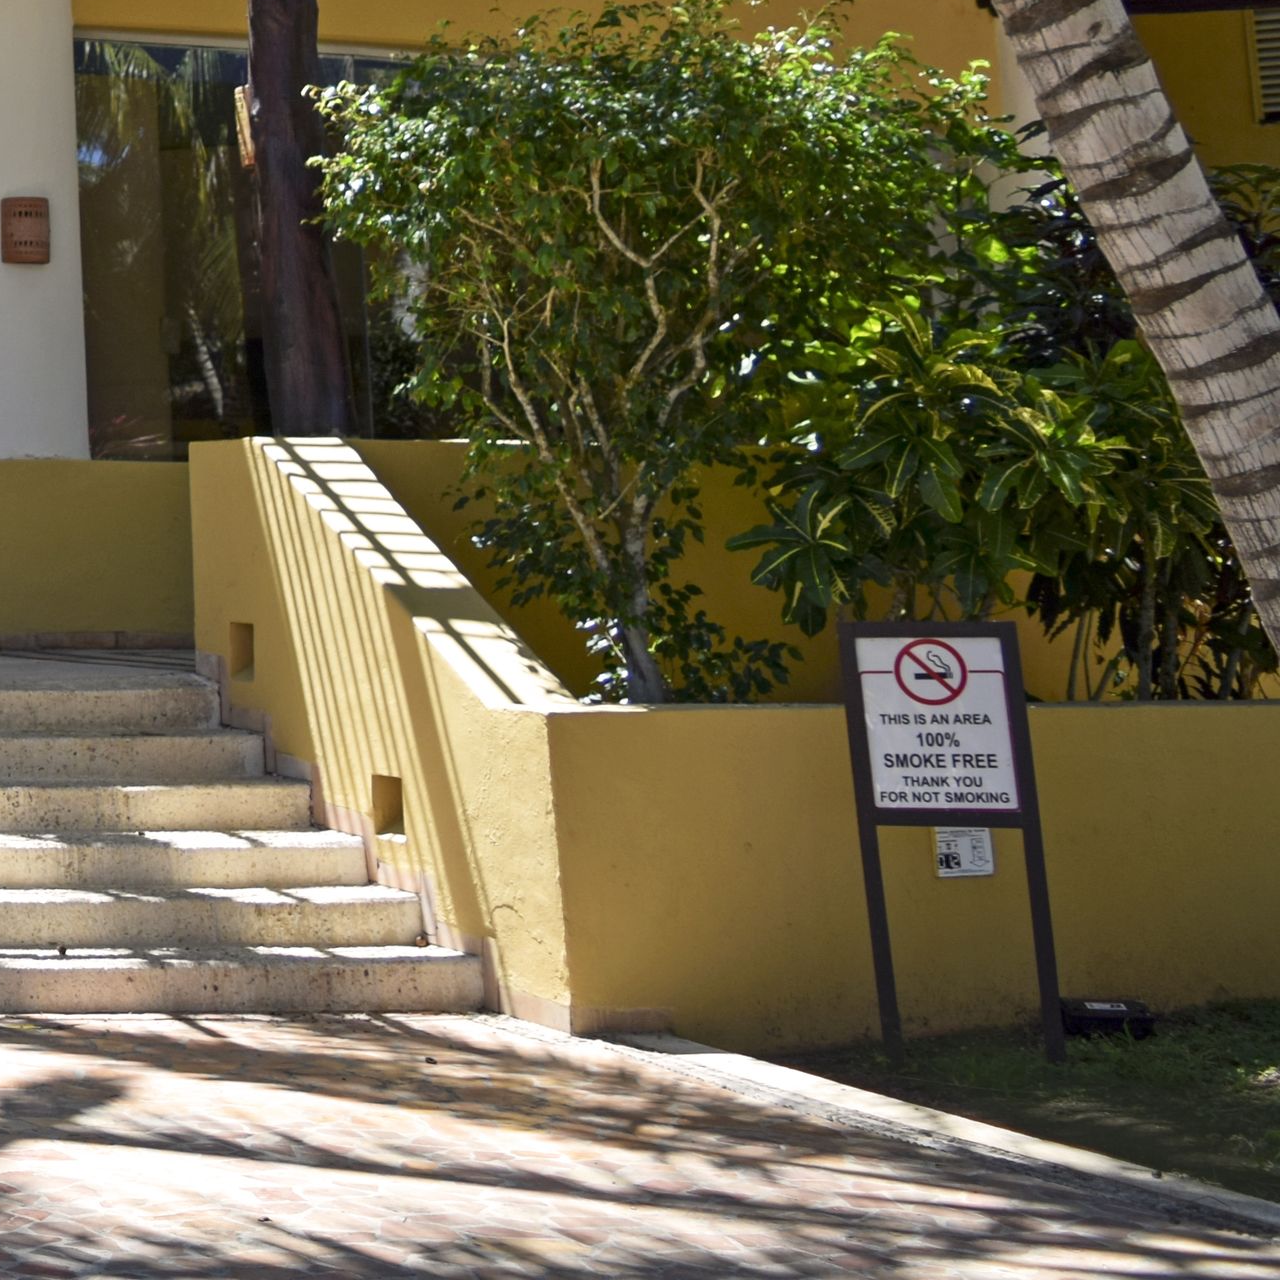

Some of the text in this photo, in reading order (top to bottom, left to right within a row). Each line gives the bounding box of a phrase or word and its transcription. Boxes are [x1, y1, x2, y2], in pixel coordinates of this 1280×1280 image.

[879, 713, 992, 726] THIS IS AN AREA
[916, 732, 960, 748] 100%
[883, 753, 999, 769] SMOKE FREE
[902, 775, 983, 788] THANK YOU
[880, 791, 1010, 804] FOR NOT SMOKING
